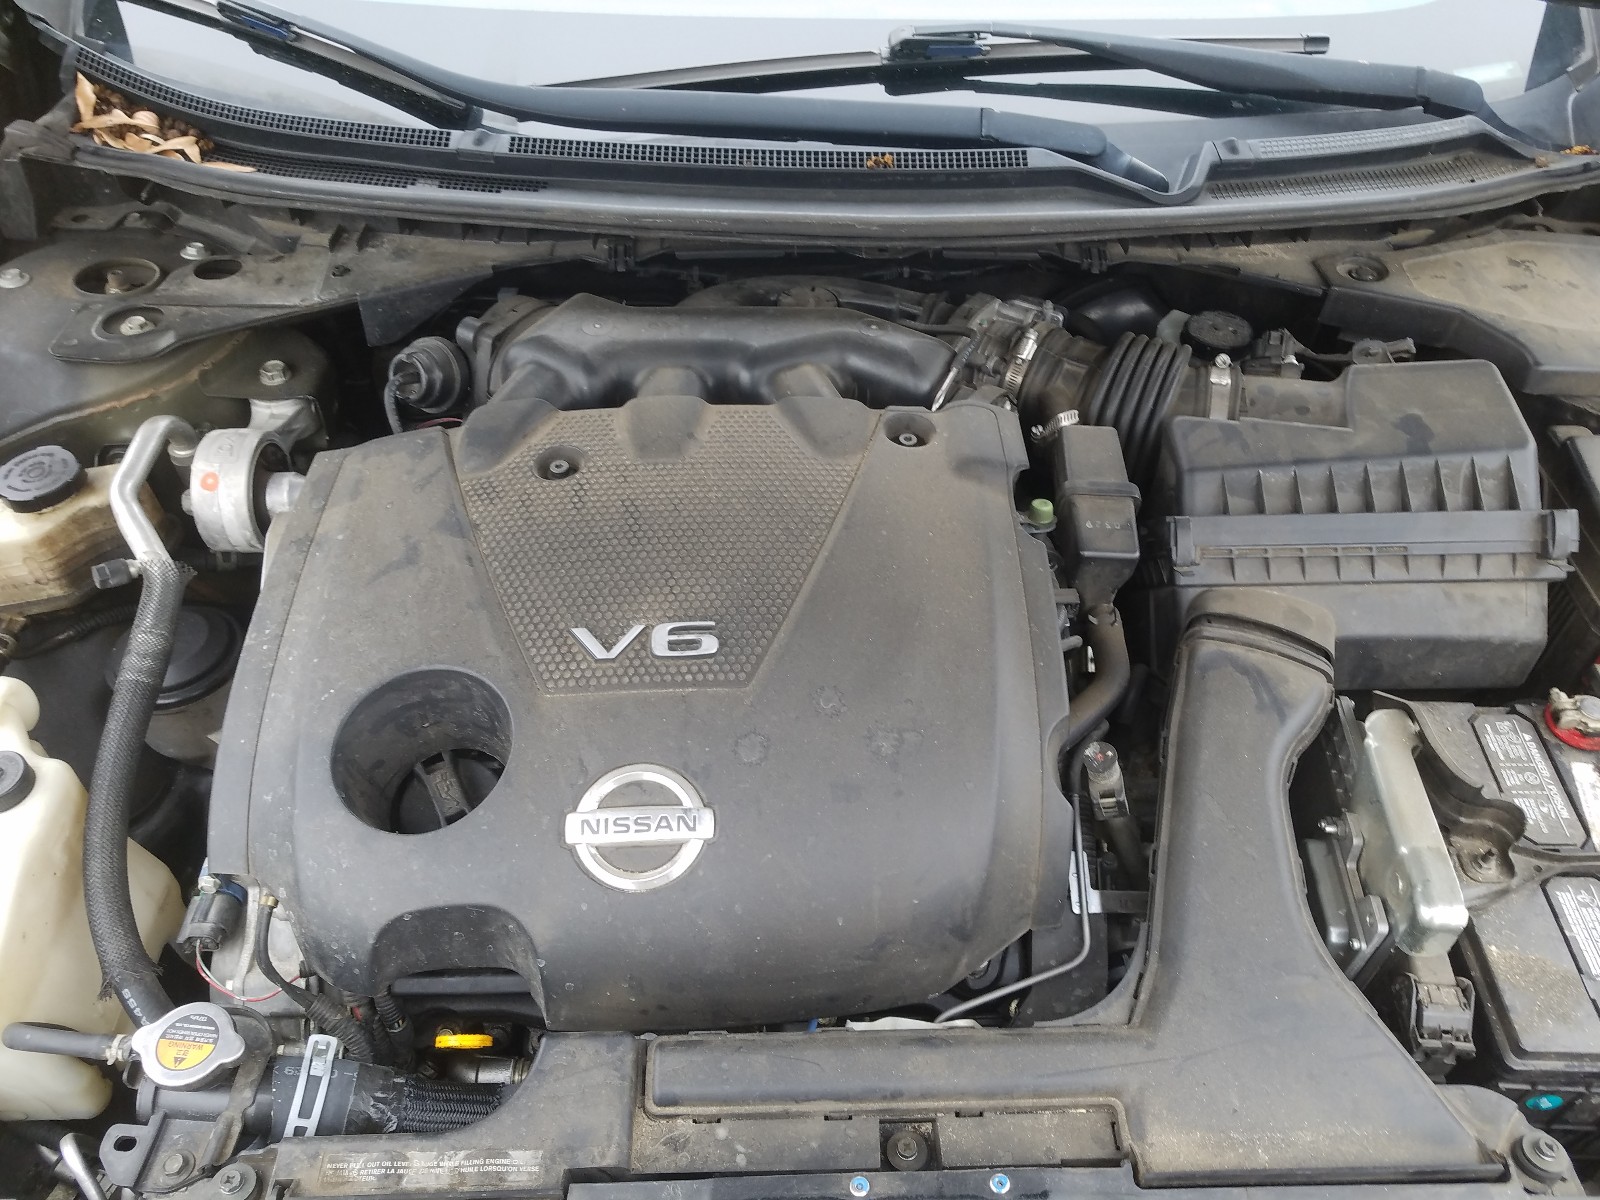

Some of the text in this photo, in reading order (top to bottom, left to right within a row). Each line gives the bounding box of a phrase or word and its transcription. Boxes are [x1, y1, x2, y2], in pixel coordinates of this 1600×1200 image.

[569, 620, 720, 660] V6
[1526, 741, 1551, 778] DANGER
[1547, 785, 1571, 819] POISON
[580, 813, 698, 836] NISSAN
[168, 1041, 204, 1051] WARNING
[359, 1168, 386, 1176] RETIRER
[386, 1167, 396, 1175] LA
[479, 1164, 518, 1172] LORSQU'ON
[460, 1158, 484, 1166] FILLING
